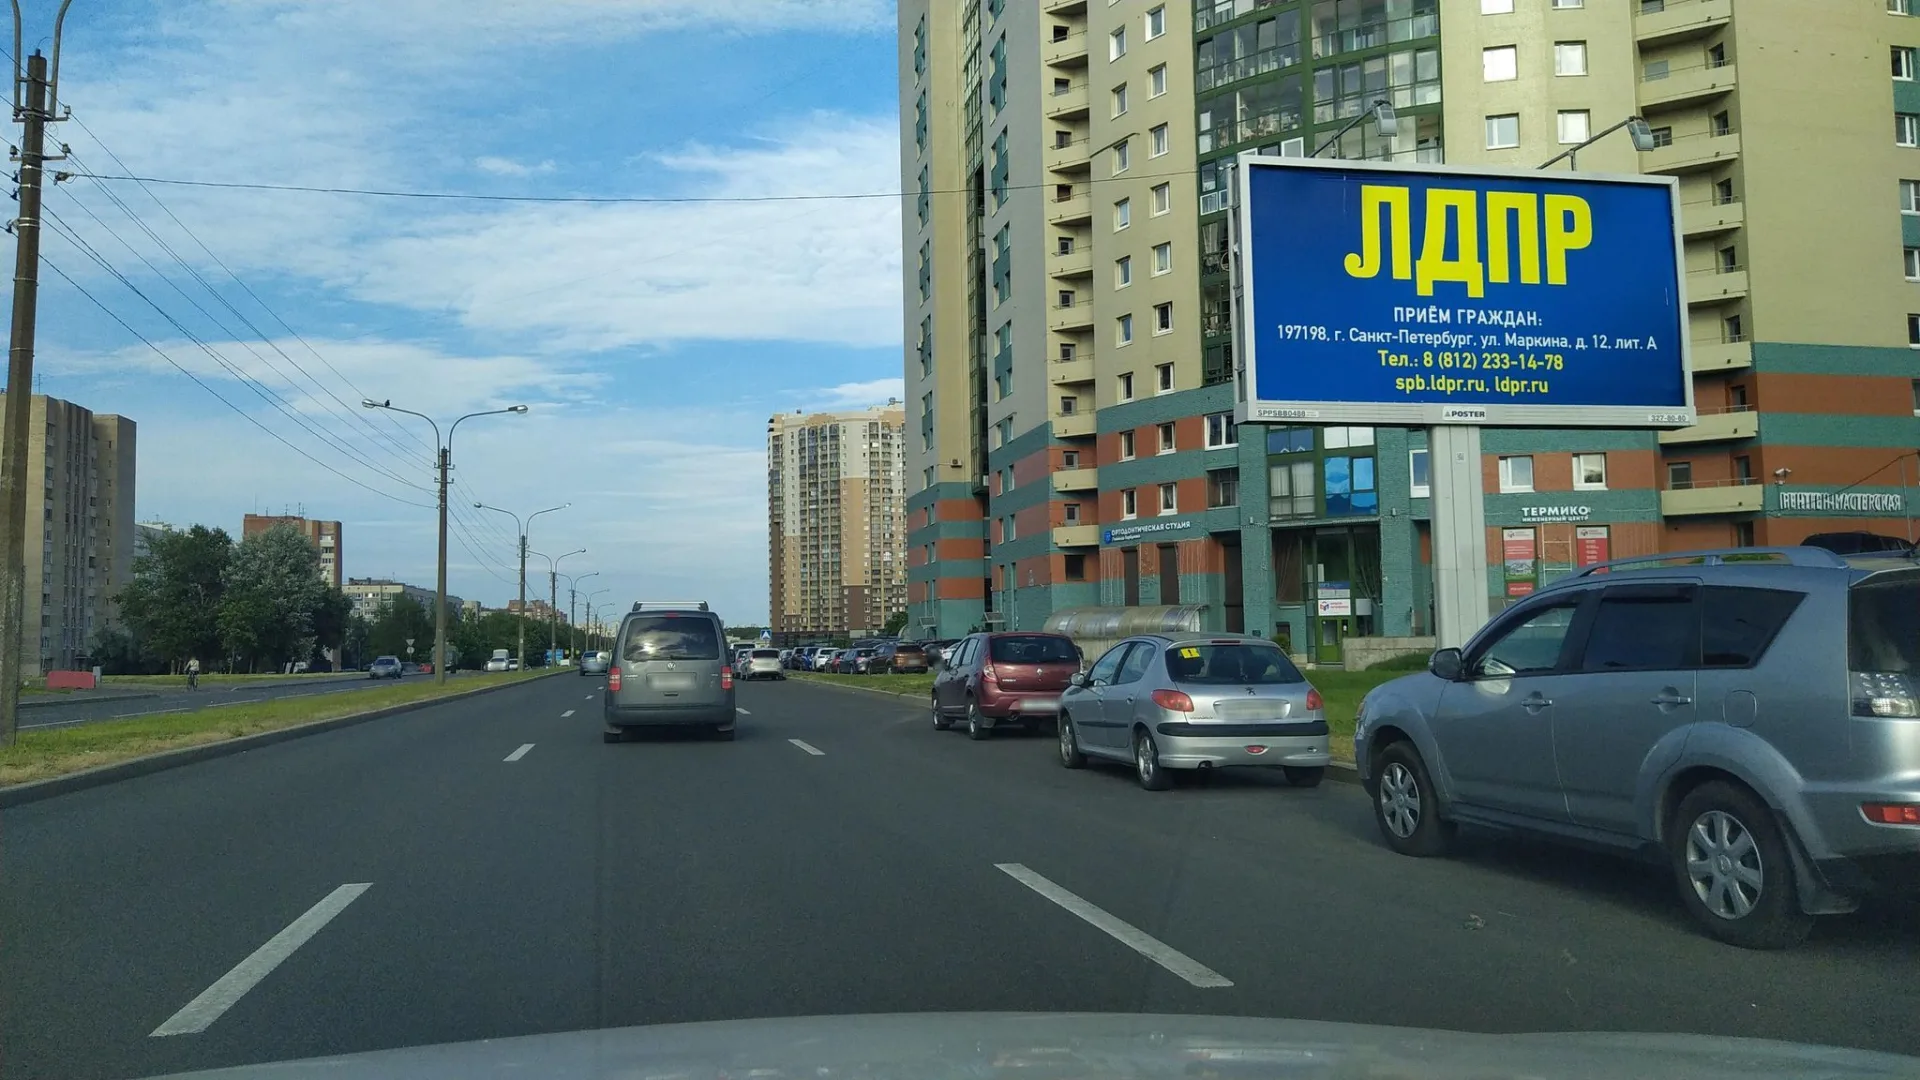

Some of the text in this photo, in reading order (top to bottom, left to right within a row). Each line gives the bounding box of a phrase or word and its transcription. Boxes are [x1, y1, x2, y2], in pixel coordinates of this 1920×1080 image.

[1344, 185, 1592, 298] ЛДПР
[1393, 305, 1543, 328] ПРИЁМ ГРАЖДАН:
[1277, 324, 1330, 342] 197198,
[1334, 330, 1345, 342] г.
[1349, 327, 1477, 349] Санкт-Петербург,
[1481, 334, 1501, 349] ул.
[1504, 332, 1572, 351] Маркина,
[1575, 337, 1589, 350] д.
[1615, 337, 1644, 350] лит.
[1646, 336, 1658, 350] А
[1377, 350, 1564, 370] Тел.: 8 (812) 233-14-78
[1395, 374, 1549, 396] spb.ldpr.ru, ldpr.ru
[1451, 410, 1486, 418] POSTER
[1522, 506, 1589, 517] ТЕРМИКО
[1165, 520, 1191, 531] СТУДИЯ
